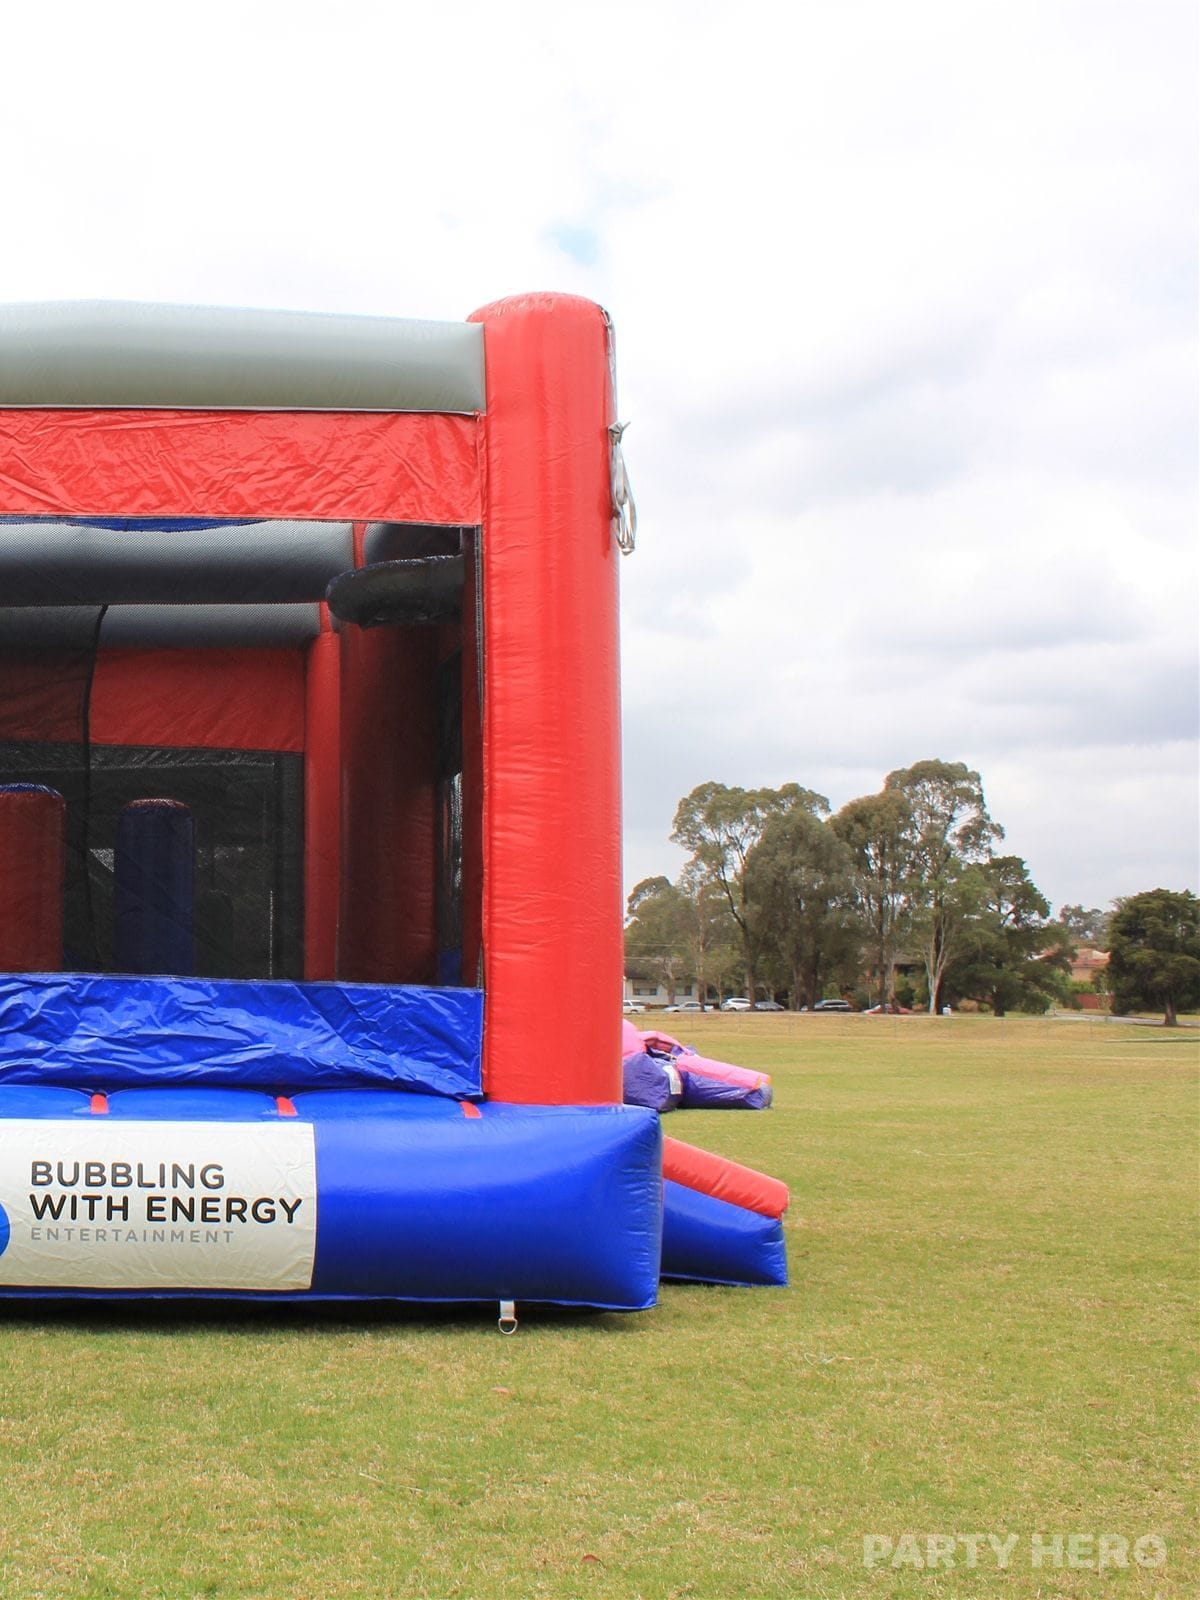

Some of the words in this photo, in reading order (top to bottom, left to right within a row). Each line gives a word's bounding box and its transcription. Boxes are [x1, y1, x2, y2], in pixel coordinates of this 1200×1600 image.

[31, 1161, 224, 1189] BUBBLING
[30, 1194, 129, 1221] WITH
[146, 1196, 302, 1224] ENERGY
[31, 1227, 234, 1243] ENTERTAINMENT
